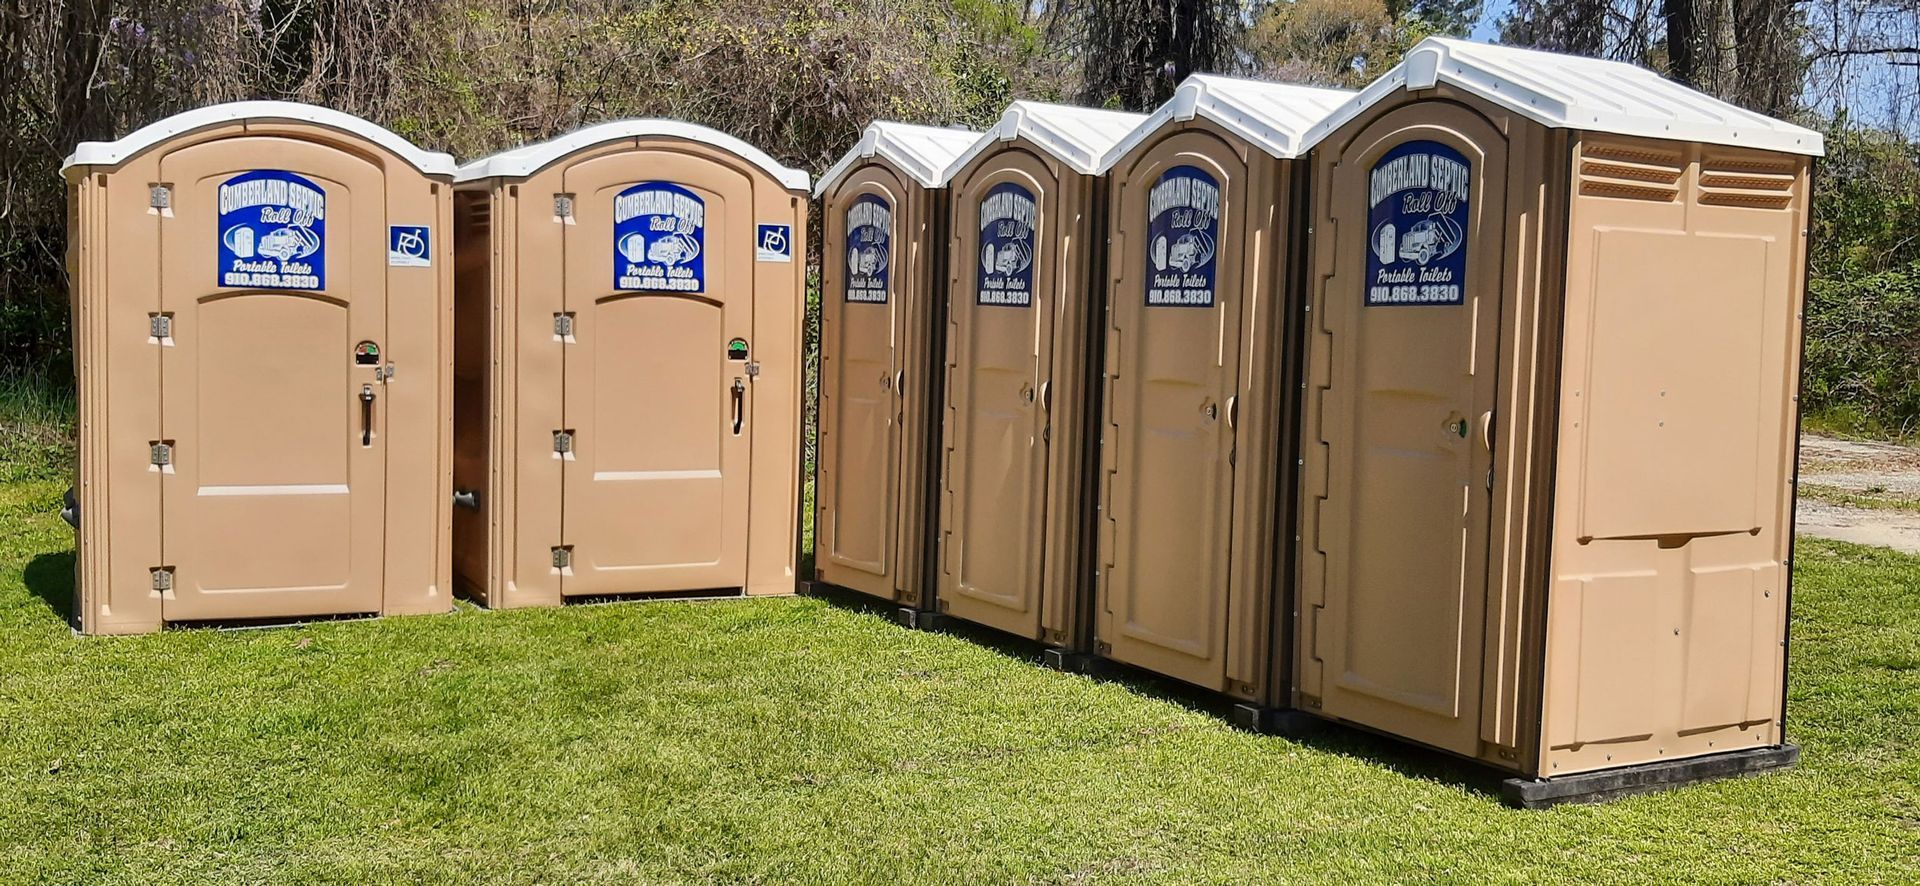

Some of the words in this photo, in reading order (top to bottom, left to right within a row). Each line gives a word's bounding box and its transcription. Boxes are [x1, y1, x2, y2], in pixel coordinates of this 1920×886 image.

[1370, 153, 1430, 209] CUMBERLAND
[1430, 154, 1468, 203] SEPTIC
[220, 179, 288, 215] CUMBERLAND
[288, 181, 324, 220] SEPTIC
[1191, 177, 1219, 220] SEPTIC
[1402, 192, 1431, 214] Roll
[1434, 190, 1459, 215] Off
[261, 206, 292, 223] Roll
[293, 208, 315, 227] Off
[615, 190, 673, 224] CUMBERLAND
[673, 192, 704, 228] SEPTIC
[650, 216, 676, 231] Roll
[677, 217, 696, 235] Off
[1171, 209, 1193, 229] Roll
[1193, 209, 1211, 230] Off
[232, 259, 277, 273] Portable
[280, 261, 312, 274] Toilets
[626, 264, 664, 277] Portable
[666, 265, 693, 278] Toilets
[1377, 267, 1415, 284] Portable
[1419, 266, 1452, 283] Toilets
[224, 272, 319, 288] 910.868.3830
[619, 276, 699, 291] 910.868.3830
[1153, 274, 1180, 288] Portable
[1182, 274, 1207, 288] Toilets
[1148, 289, 1212, 304] 910.868.3830
[1370, 284, 1459, 304] 910.868.3830
